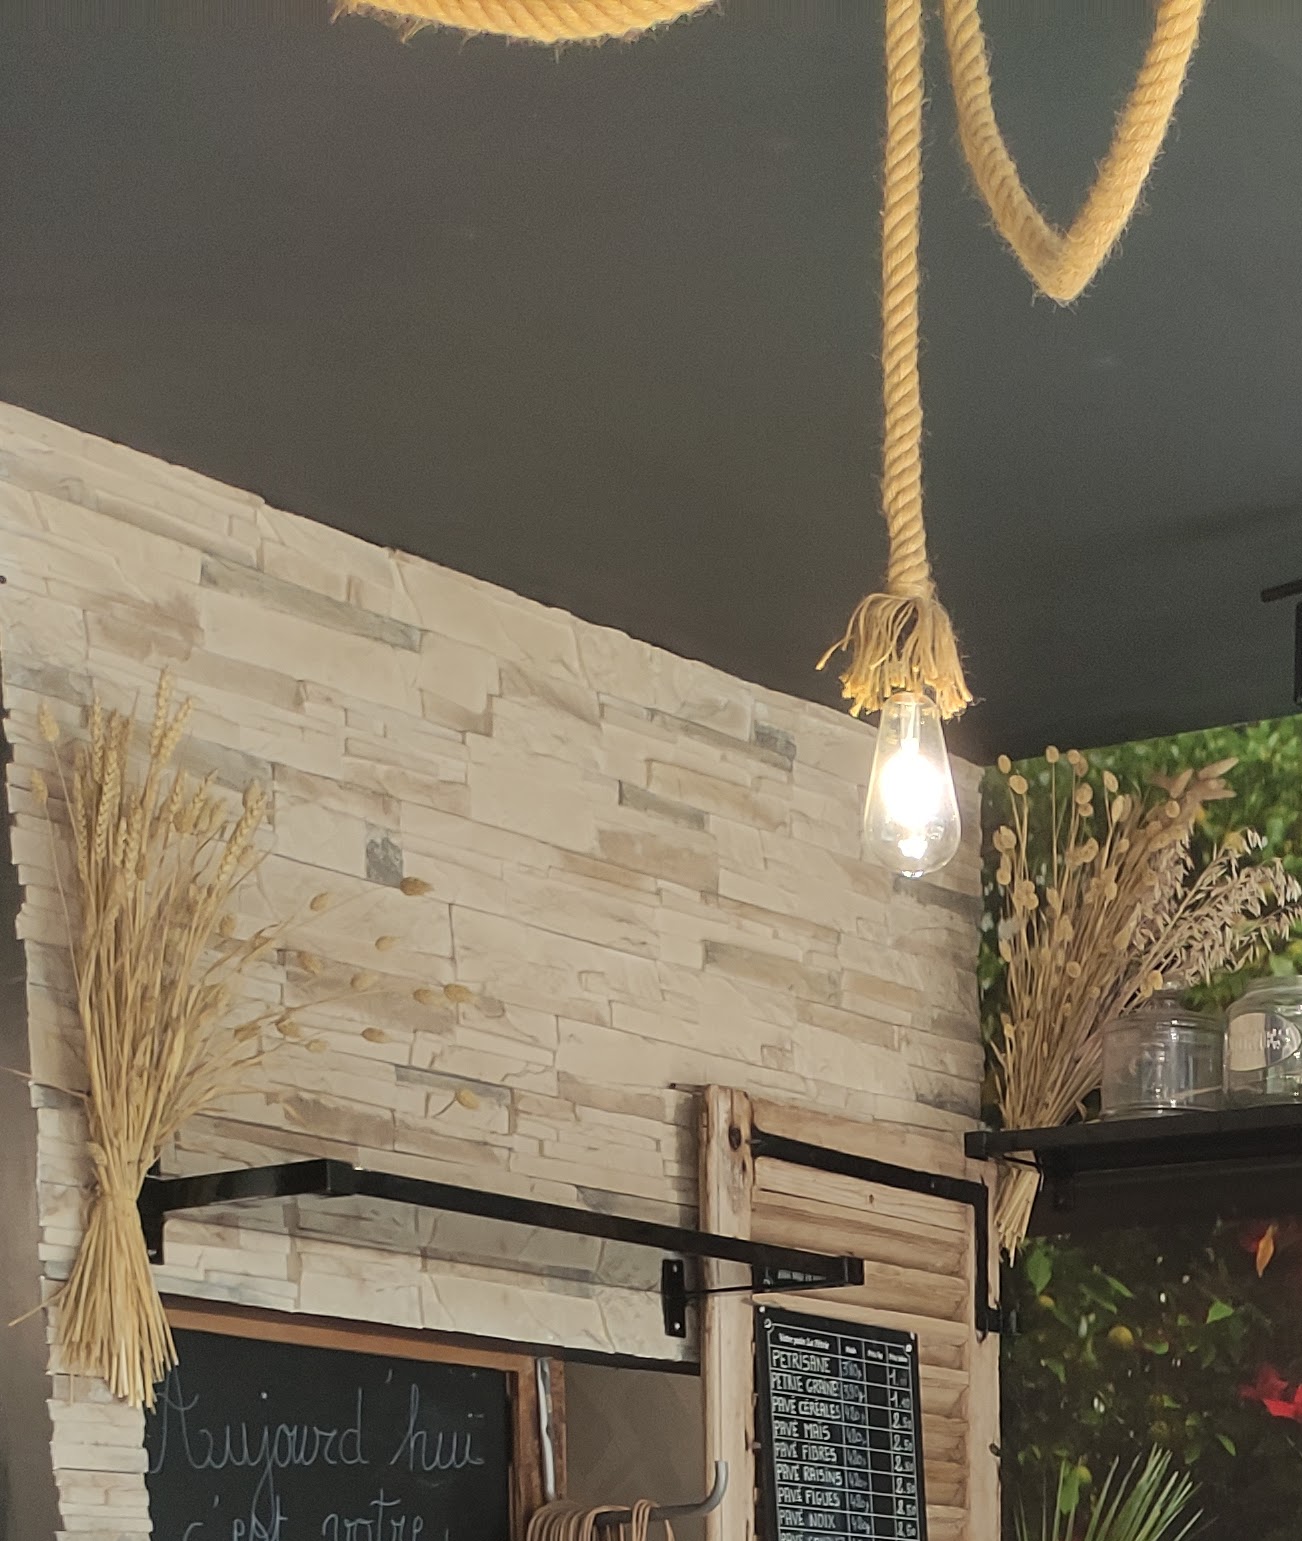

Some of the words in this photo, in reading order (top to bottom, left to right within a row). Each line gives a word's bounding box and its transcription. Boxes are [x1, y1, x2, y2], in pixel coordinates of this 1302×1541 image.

[772, 1349, 831, 1373] PETRISANE
[805, 1490, 840, 1507] FIGUES
[808, 1513, 836, 1529] NOIX
